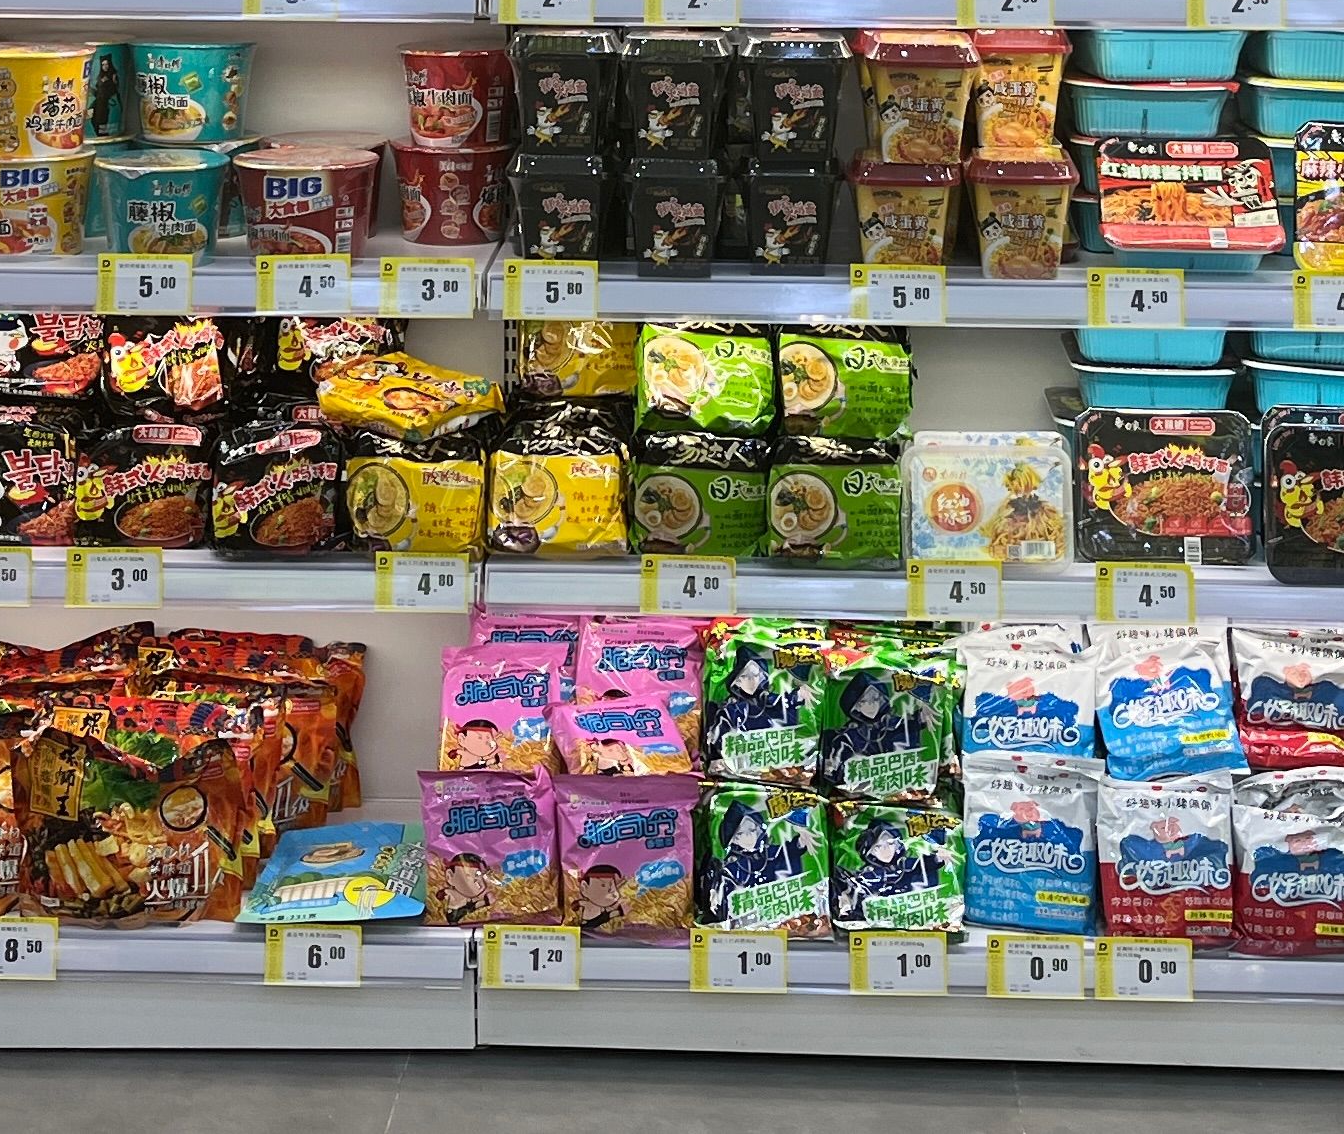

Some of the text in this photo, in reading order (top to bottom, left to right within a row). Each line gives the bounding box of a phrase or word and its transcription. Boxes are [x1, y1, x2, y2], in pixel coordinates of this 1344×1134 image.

[264, 176, 322, 199] BIG
[158, 220, 196, 235] 牛肉面
[138, 275, 176, 298] 5.00
[298, 274, 335, 297] 4.50
[1130, 289, 1168, 313] 4.50
[111, 568, 148, 591] 3.00
[949, 580, 986, 603] 4.50
[1138, 584, 1176, 608] 4.50
[725, 728, 795, 755] 精品巴西
[750, 742, 805, 766] 烤肉味
[848, 753, 916, 781] 精品巴西
[872, 770, 930, 792] 烤肉味
[4, 938, 42, 963] 8.50
[308, 945, 346, 969] 6.00
[529, 948, 563, 972] 1.20
[738, 951, 771, 975] 1.00
[897, 954, 931, 977] 1.00
[1030, 958, 1068, 981] 0.90
[1138, 959, 1177, 984] 0.90
